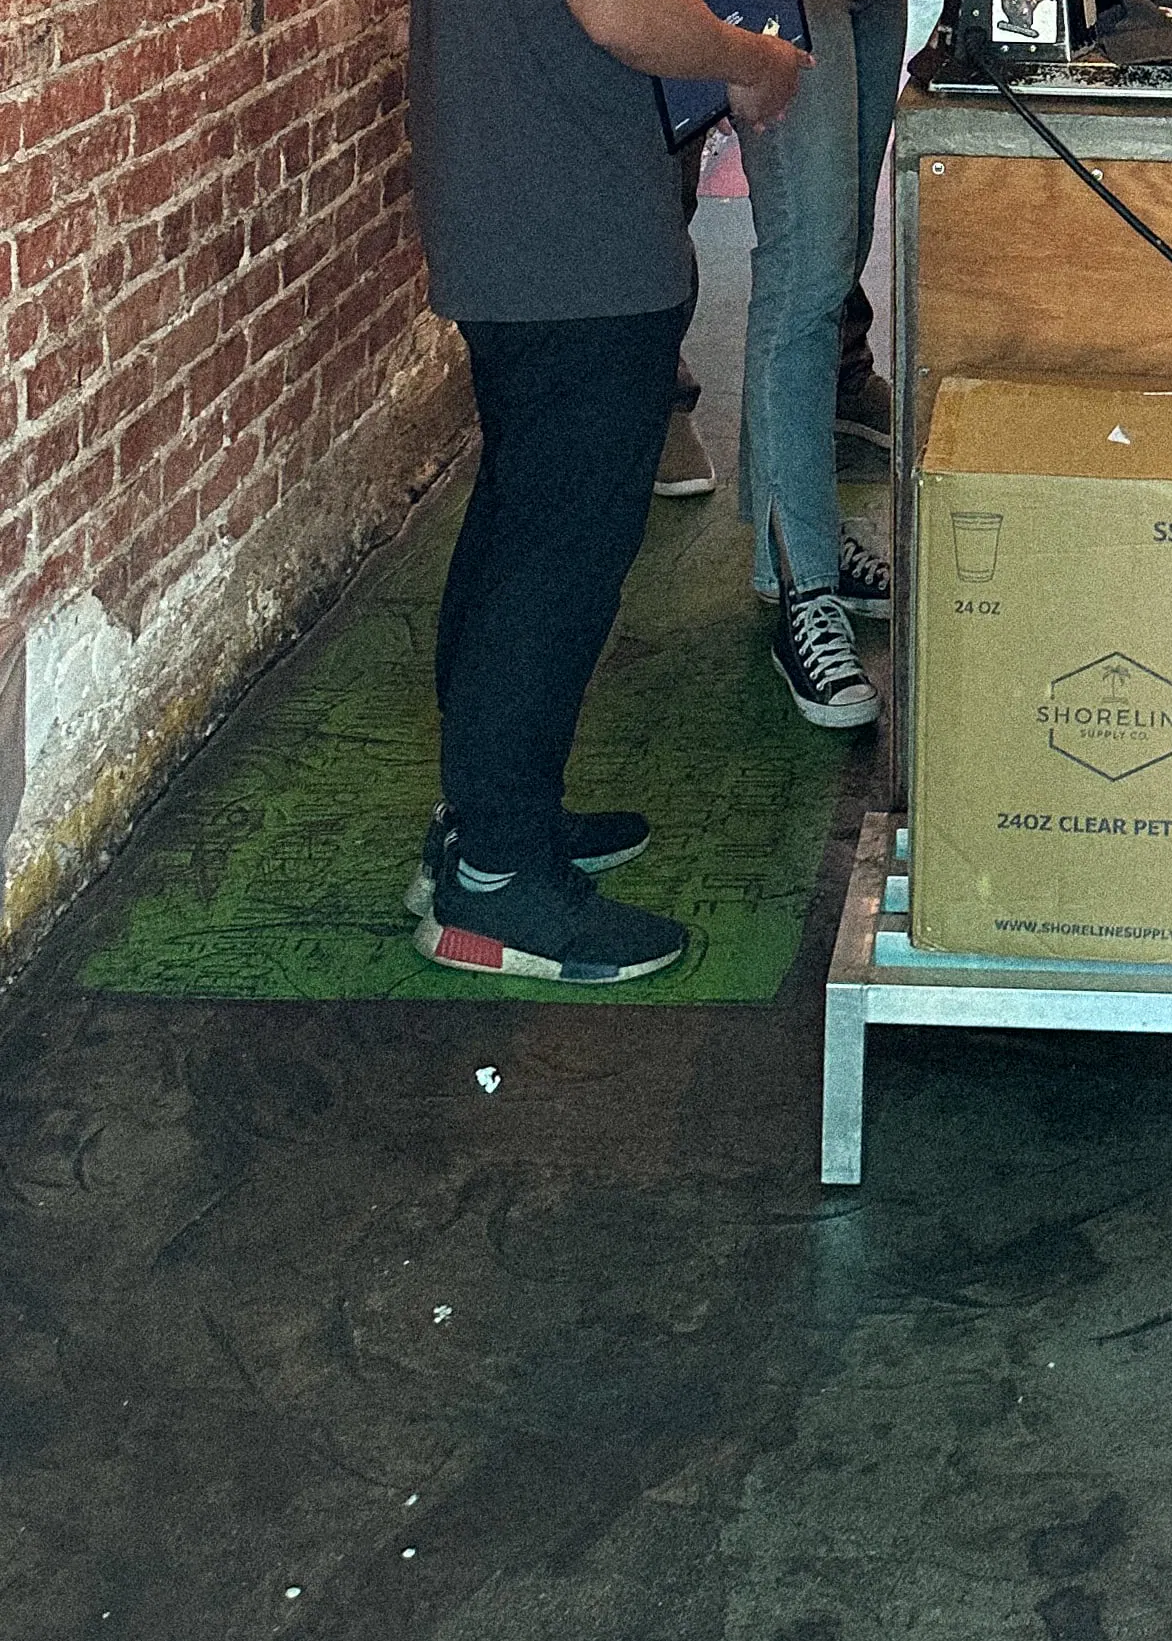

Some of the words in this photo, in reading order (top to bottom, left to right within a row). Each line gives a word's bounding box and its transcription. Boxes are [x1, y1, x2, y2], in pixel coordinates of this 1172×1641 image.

[954, 599, 974, 614] 24
[979, 601, 1001, 615] OZ
[1080, 729, 1125, 740] SUPPLY
[997, 813, 1052, 831] 24OZ
[1059, 816, 1127, 834] CLEAR
[1134, 819, 1172, 837] PET
